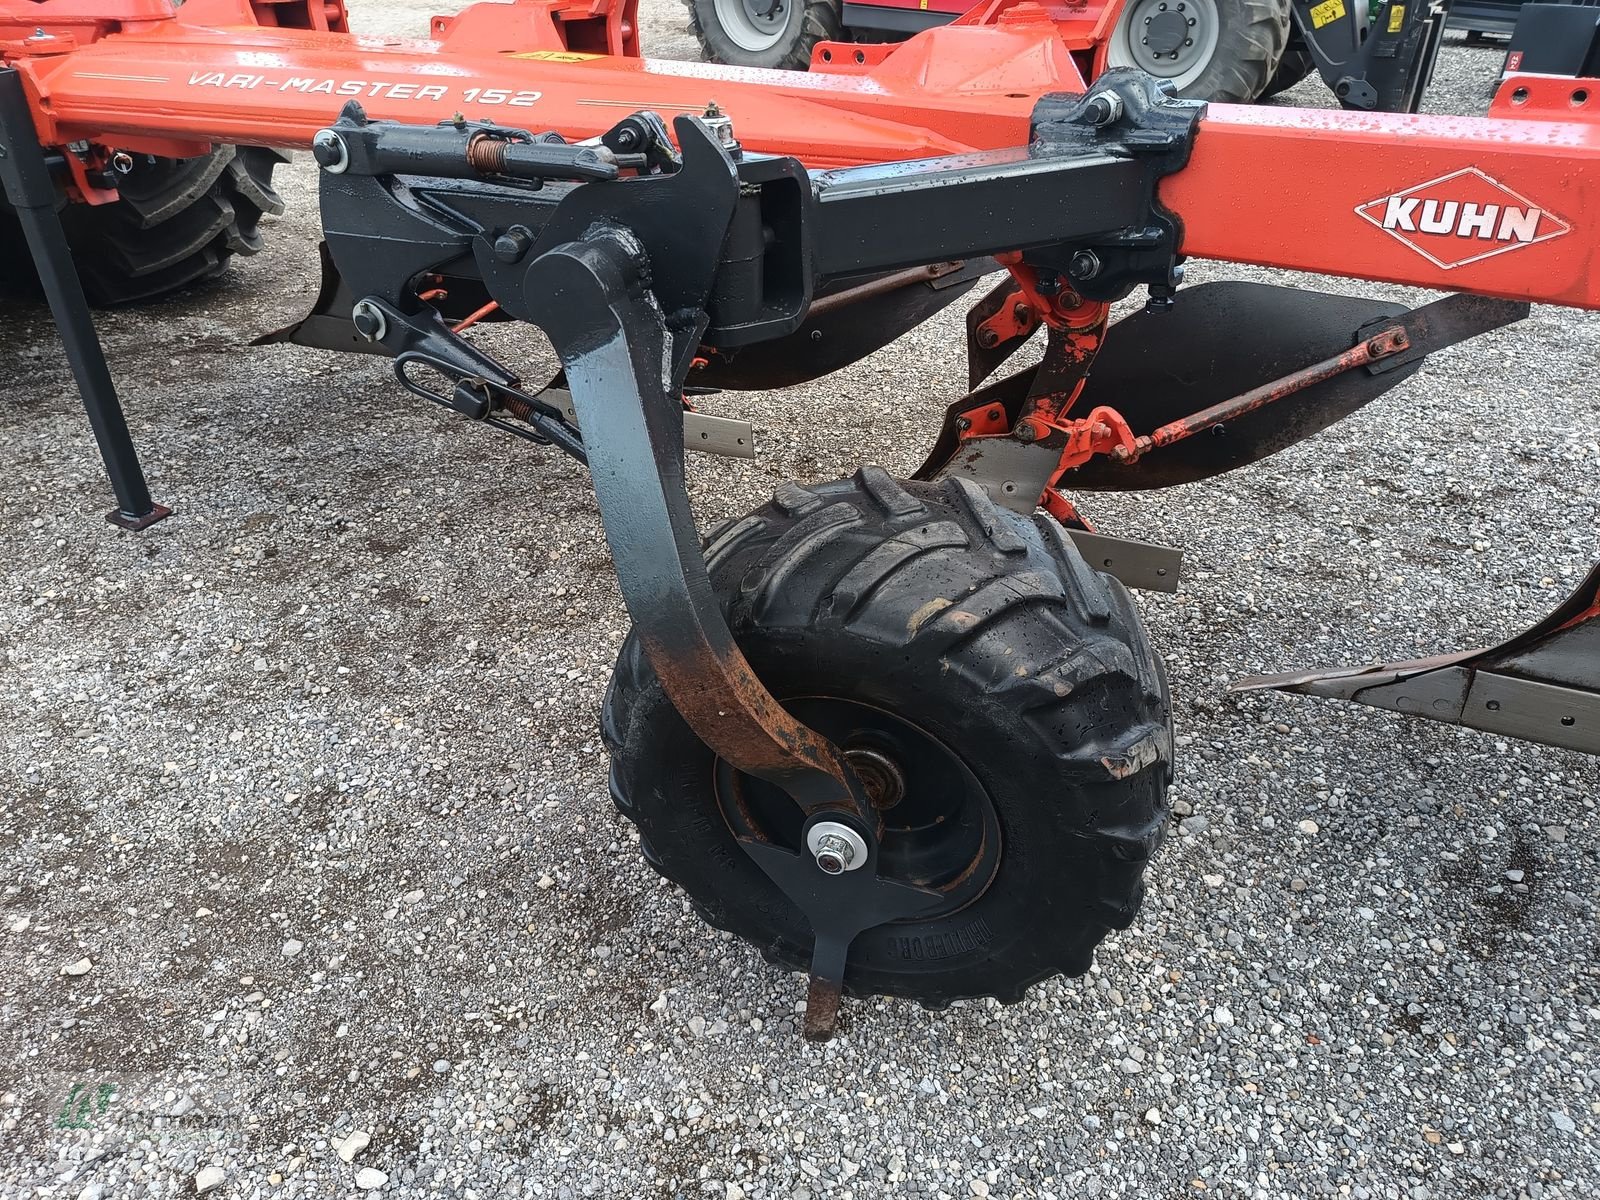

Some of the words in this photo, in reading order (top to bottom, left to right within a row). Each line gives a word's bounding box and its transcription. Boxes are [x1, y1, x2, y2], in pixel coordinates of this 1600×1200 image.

[187, 71, 449, 102] VARI-MASTER
[462, 87, 544, 108] 152
[1383, 196, 1542, 242] KUHN
